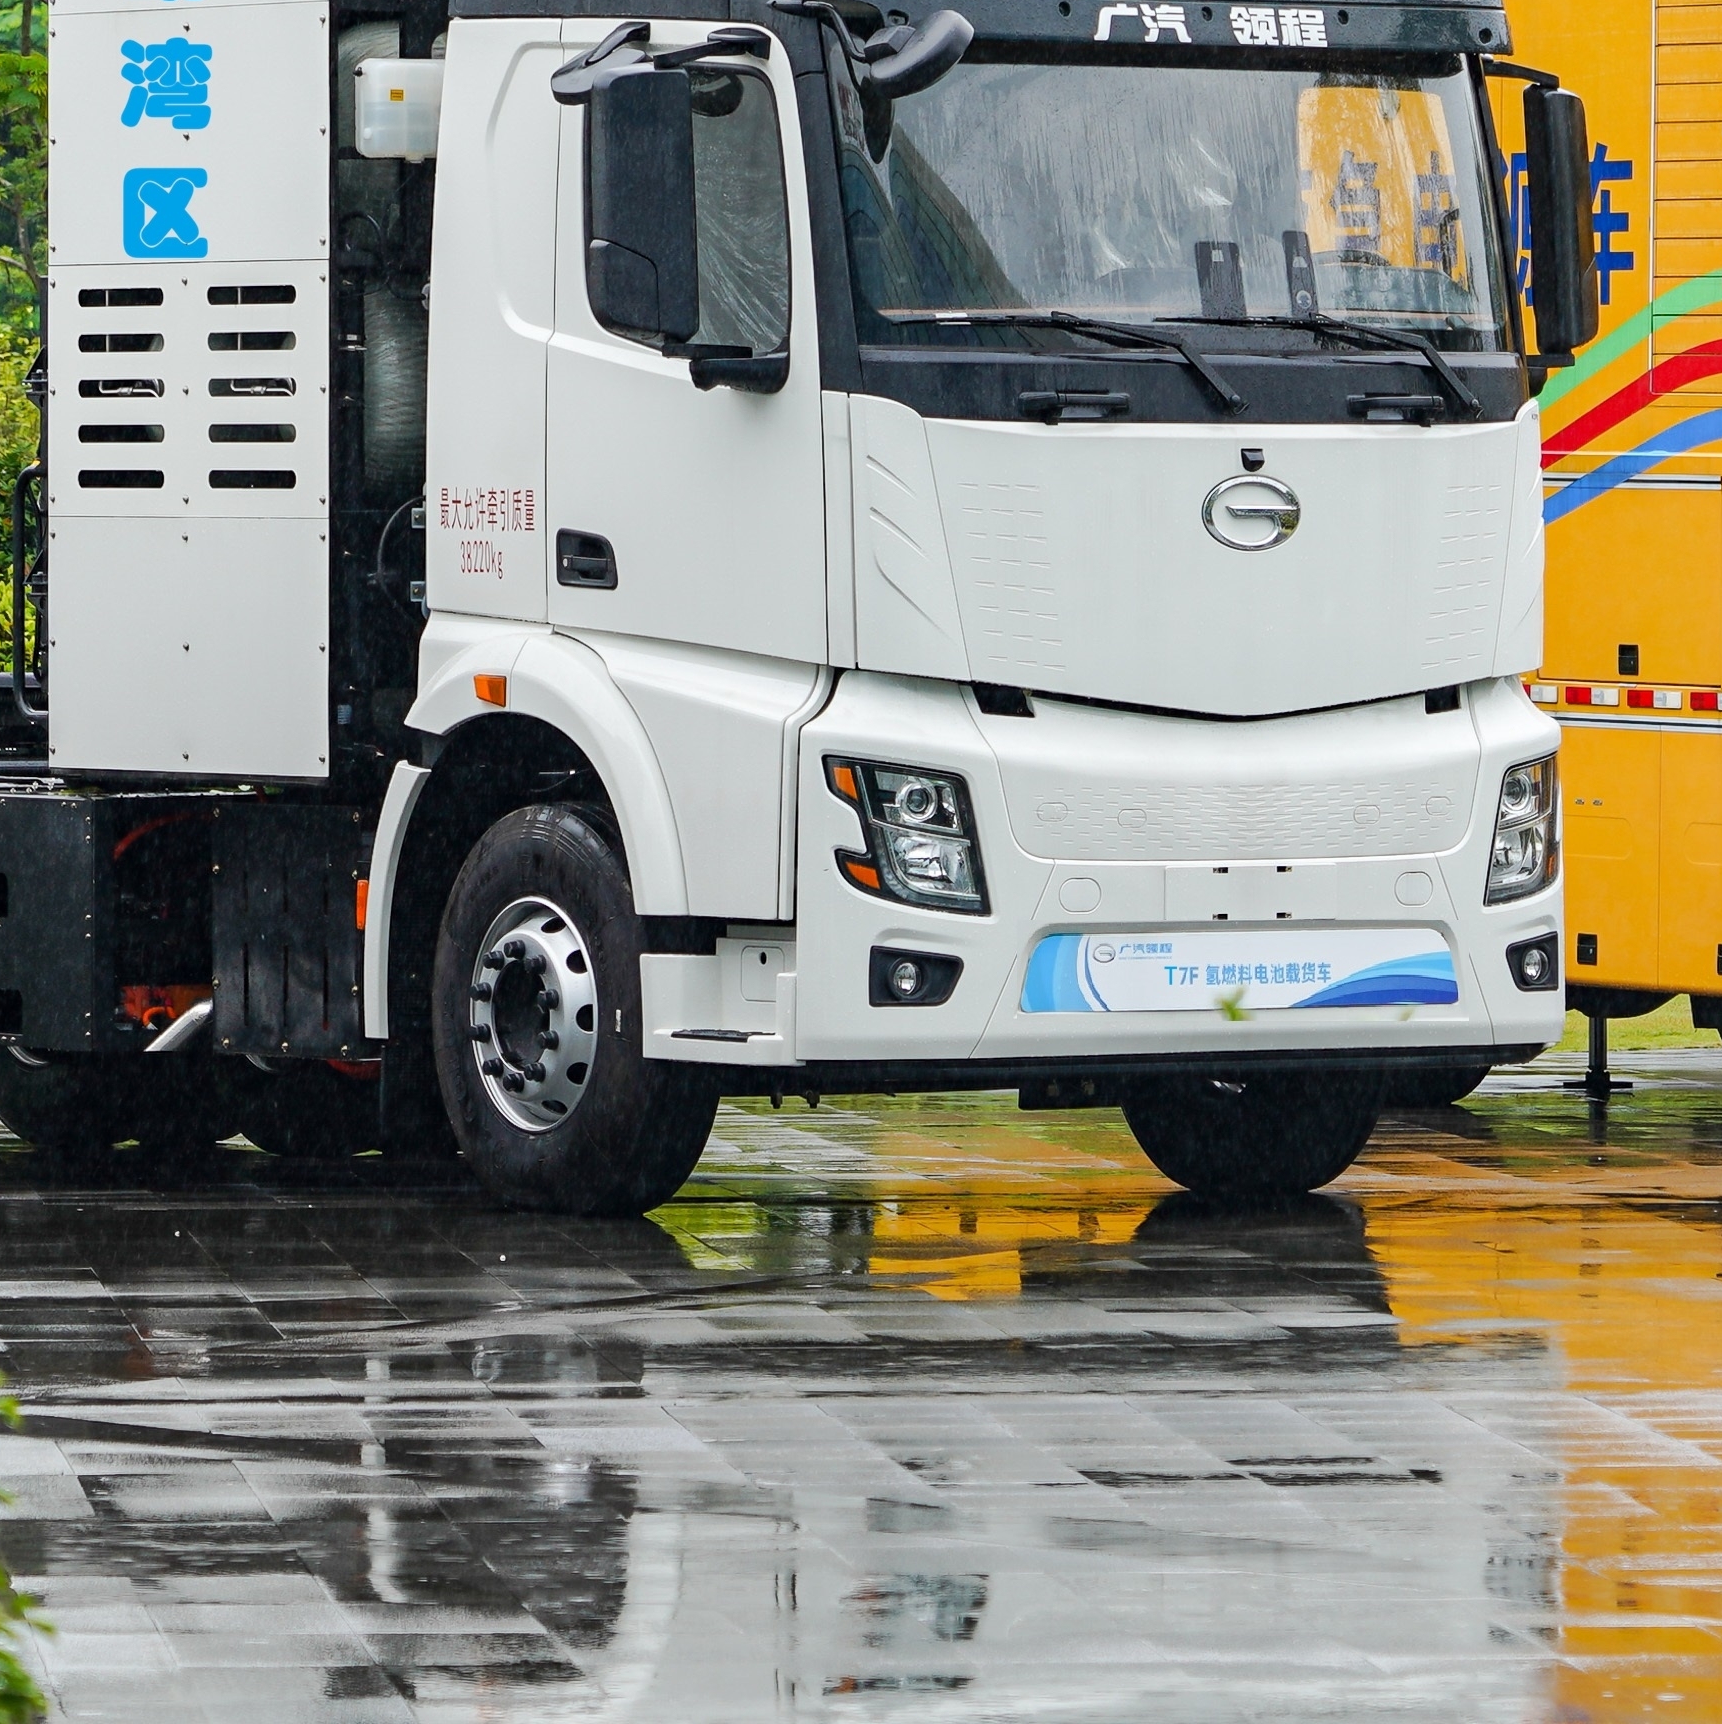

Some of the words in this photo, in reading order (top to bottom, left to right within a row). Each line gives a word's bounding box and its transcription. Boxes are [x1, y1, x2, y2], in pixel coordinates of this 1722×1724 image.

[1093, 3, 1193, 44] 广汽
[1229, 5, 1328, 48] 领程
[440, 486, 535, 532] 最大允许牵引质量
[460, 540, 503, 580] 38220kg
[1164, 965, 1199, 986] T7F
[1205, 962, 1332, 986] 氢燃料电池载货车
